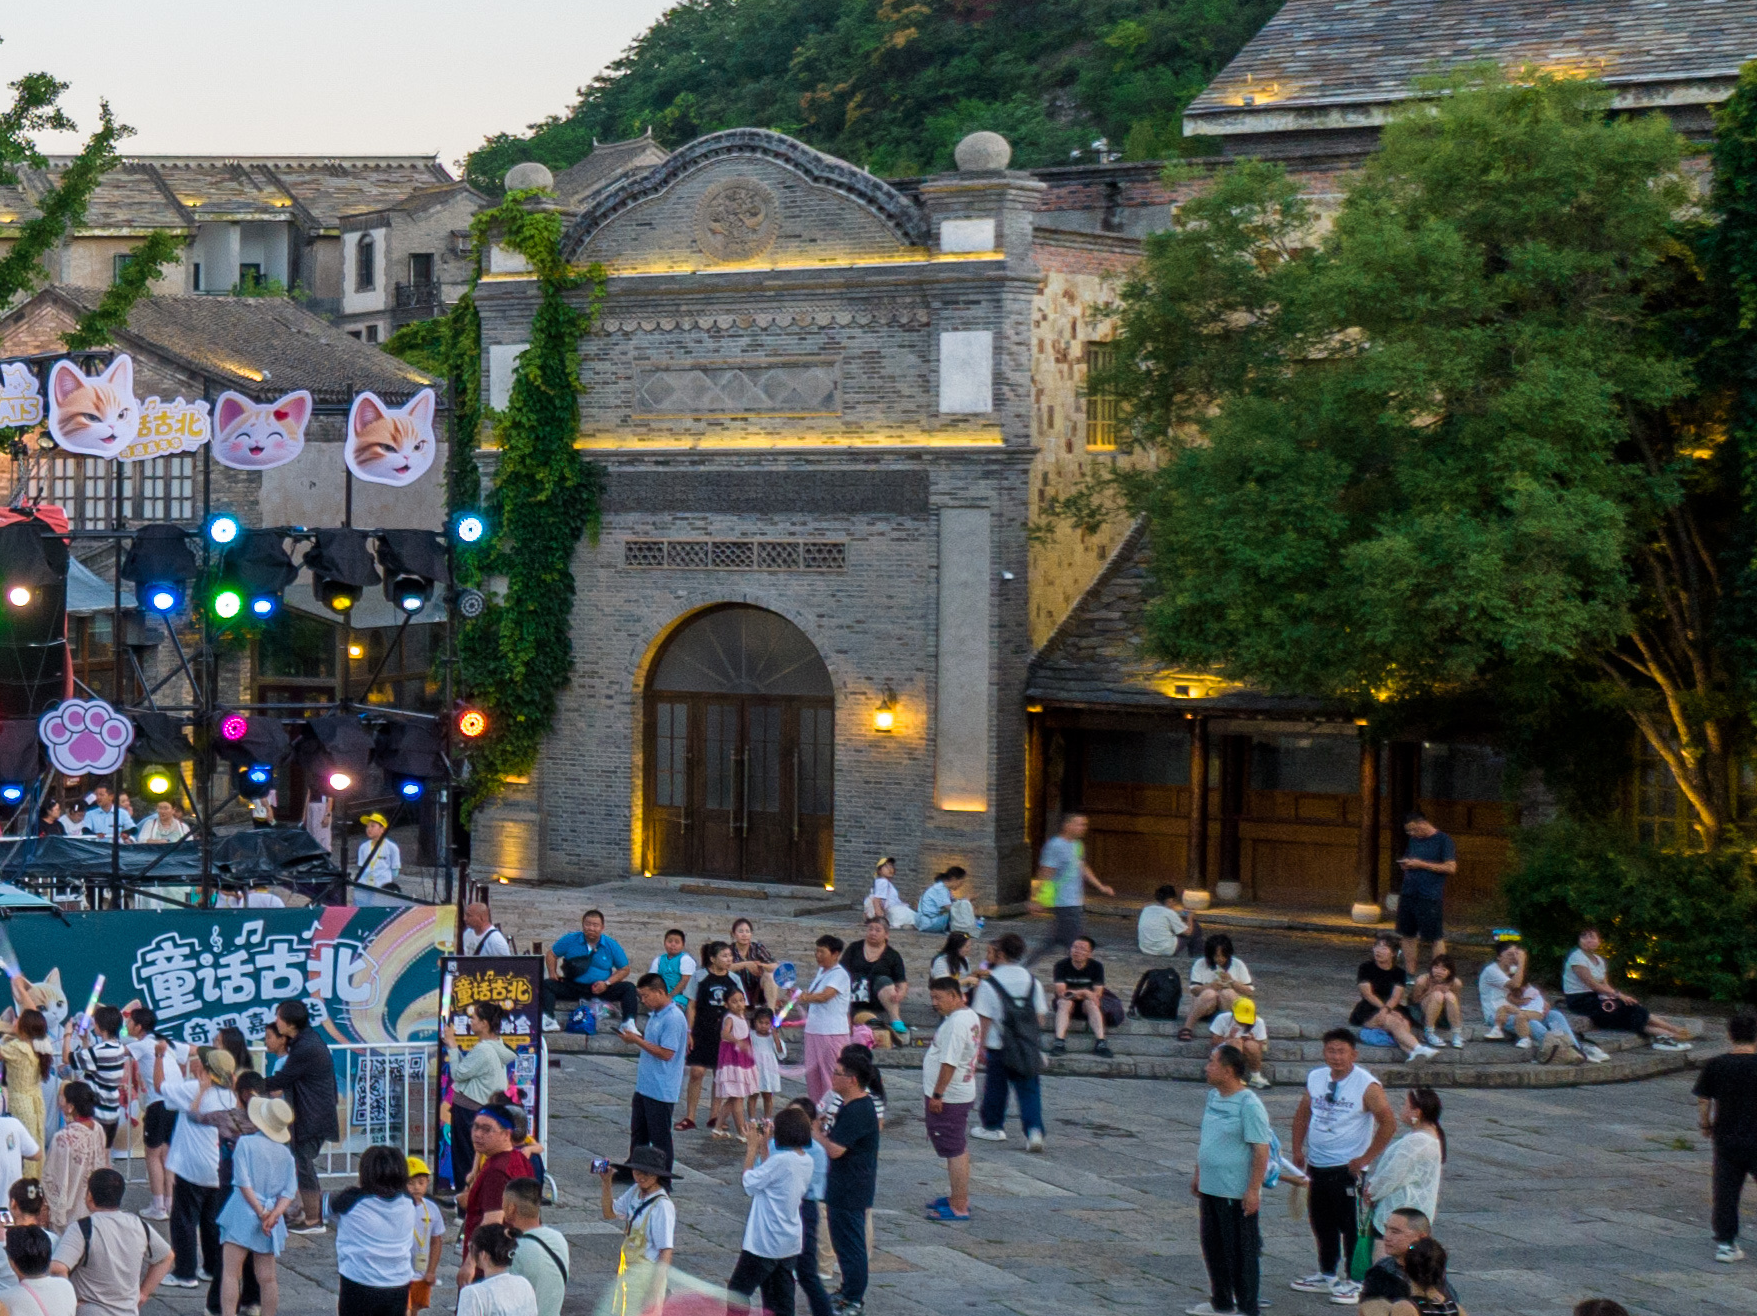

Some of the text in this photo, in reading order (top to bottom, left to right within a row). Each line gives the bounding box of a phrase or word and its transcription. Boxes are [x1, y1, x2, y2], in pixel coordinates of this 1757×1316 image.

[139, 940, 375, 1019] 童话古北
[453, 978, 530, 1008] 童话古北
